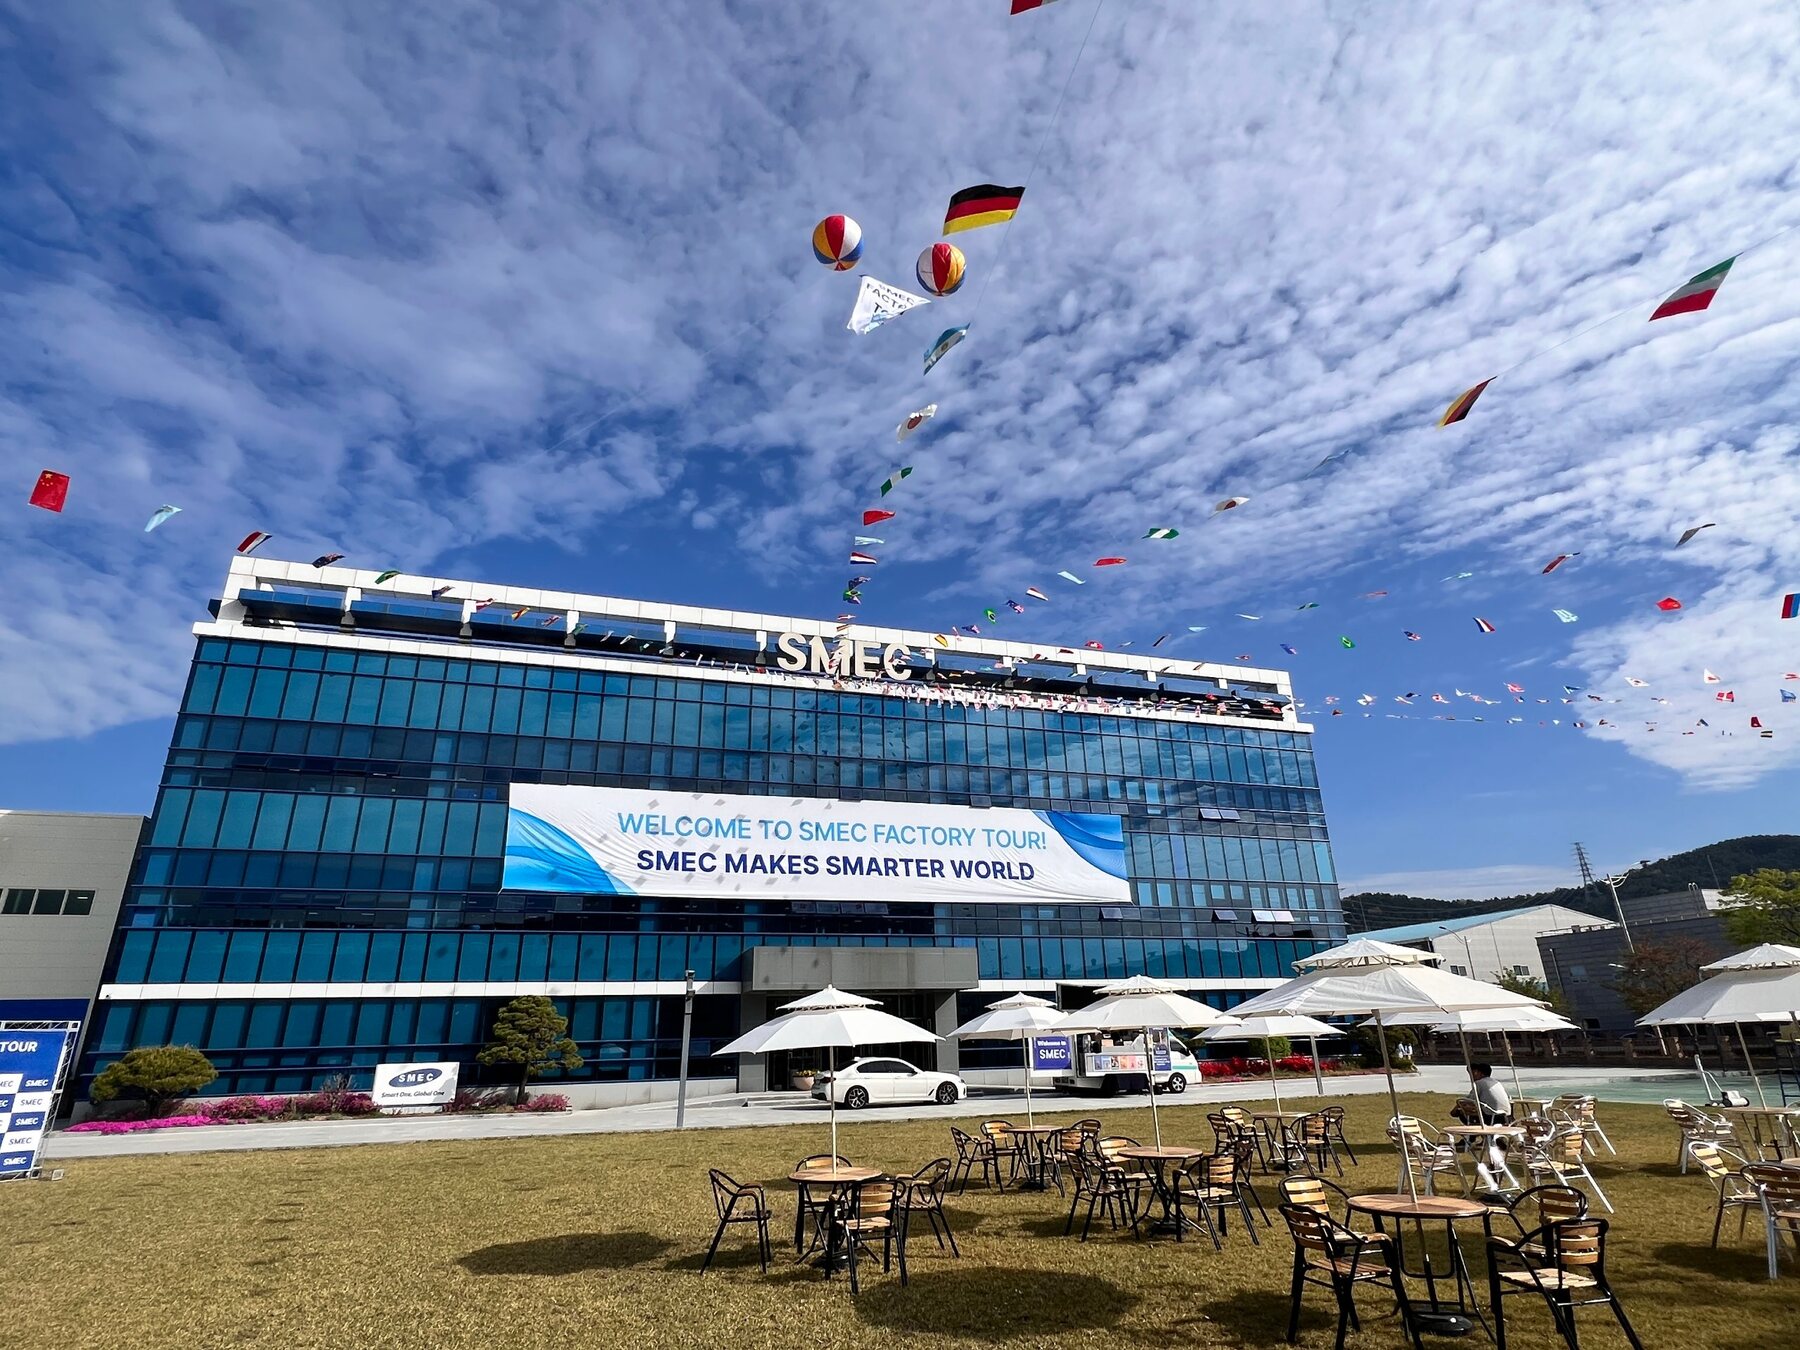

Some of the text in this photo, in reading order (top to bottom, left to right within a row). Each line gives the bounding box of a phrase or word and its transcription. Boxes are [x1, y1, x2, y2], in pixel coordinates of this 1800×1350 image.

[776, 631, 912, 681] SMEC
[617, 812, 1047, 850] WELCOME TO SMEC FACTORY TOUR!
[637, 849, 1036, 881] SMEC MAKES SMARTER WORLD
[1039, 1048, 1066, 1060] SMEC
[398, 1073, 434, 1083] SMEC
[25, 1079, 49, 1088] SMEC
[20, 1098, 43, 1106] SMEC
[15, 1117, 39, 1126] SMEC
[8, 1137, 32, 1146] SMEC
[3, 1156, 27, 1166] SMEC
